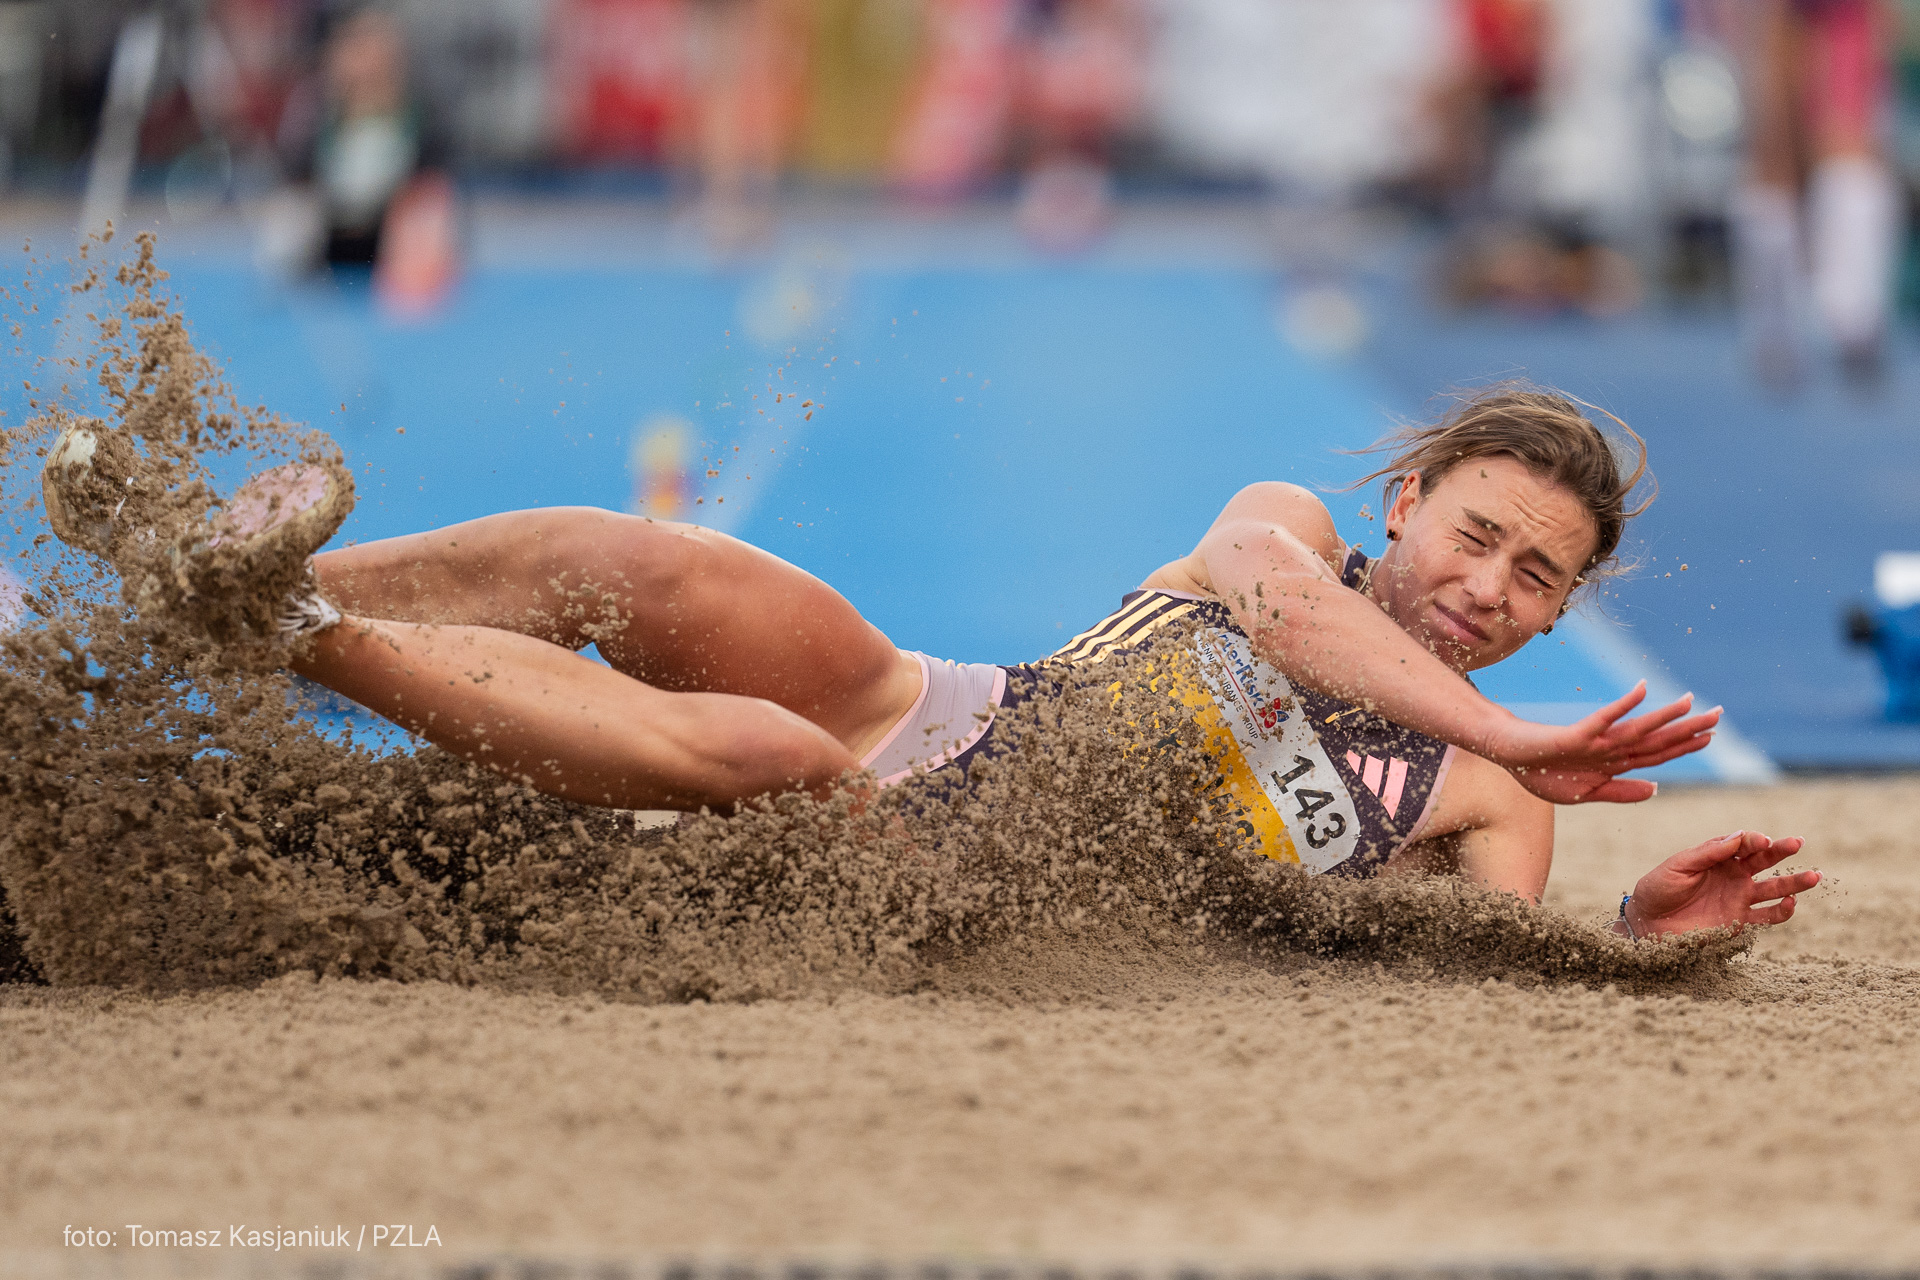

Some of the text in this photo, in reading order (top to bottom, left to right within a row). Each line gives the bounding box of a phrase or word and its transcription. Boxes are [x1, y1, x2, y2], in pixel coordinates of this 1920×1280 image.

[1214, 631, 1264, 707] nterRisk
[1243, 710, 1259, 740] ROUP
[1270, 754, 1347, 849] 143
